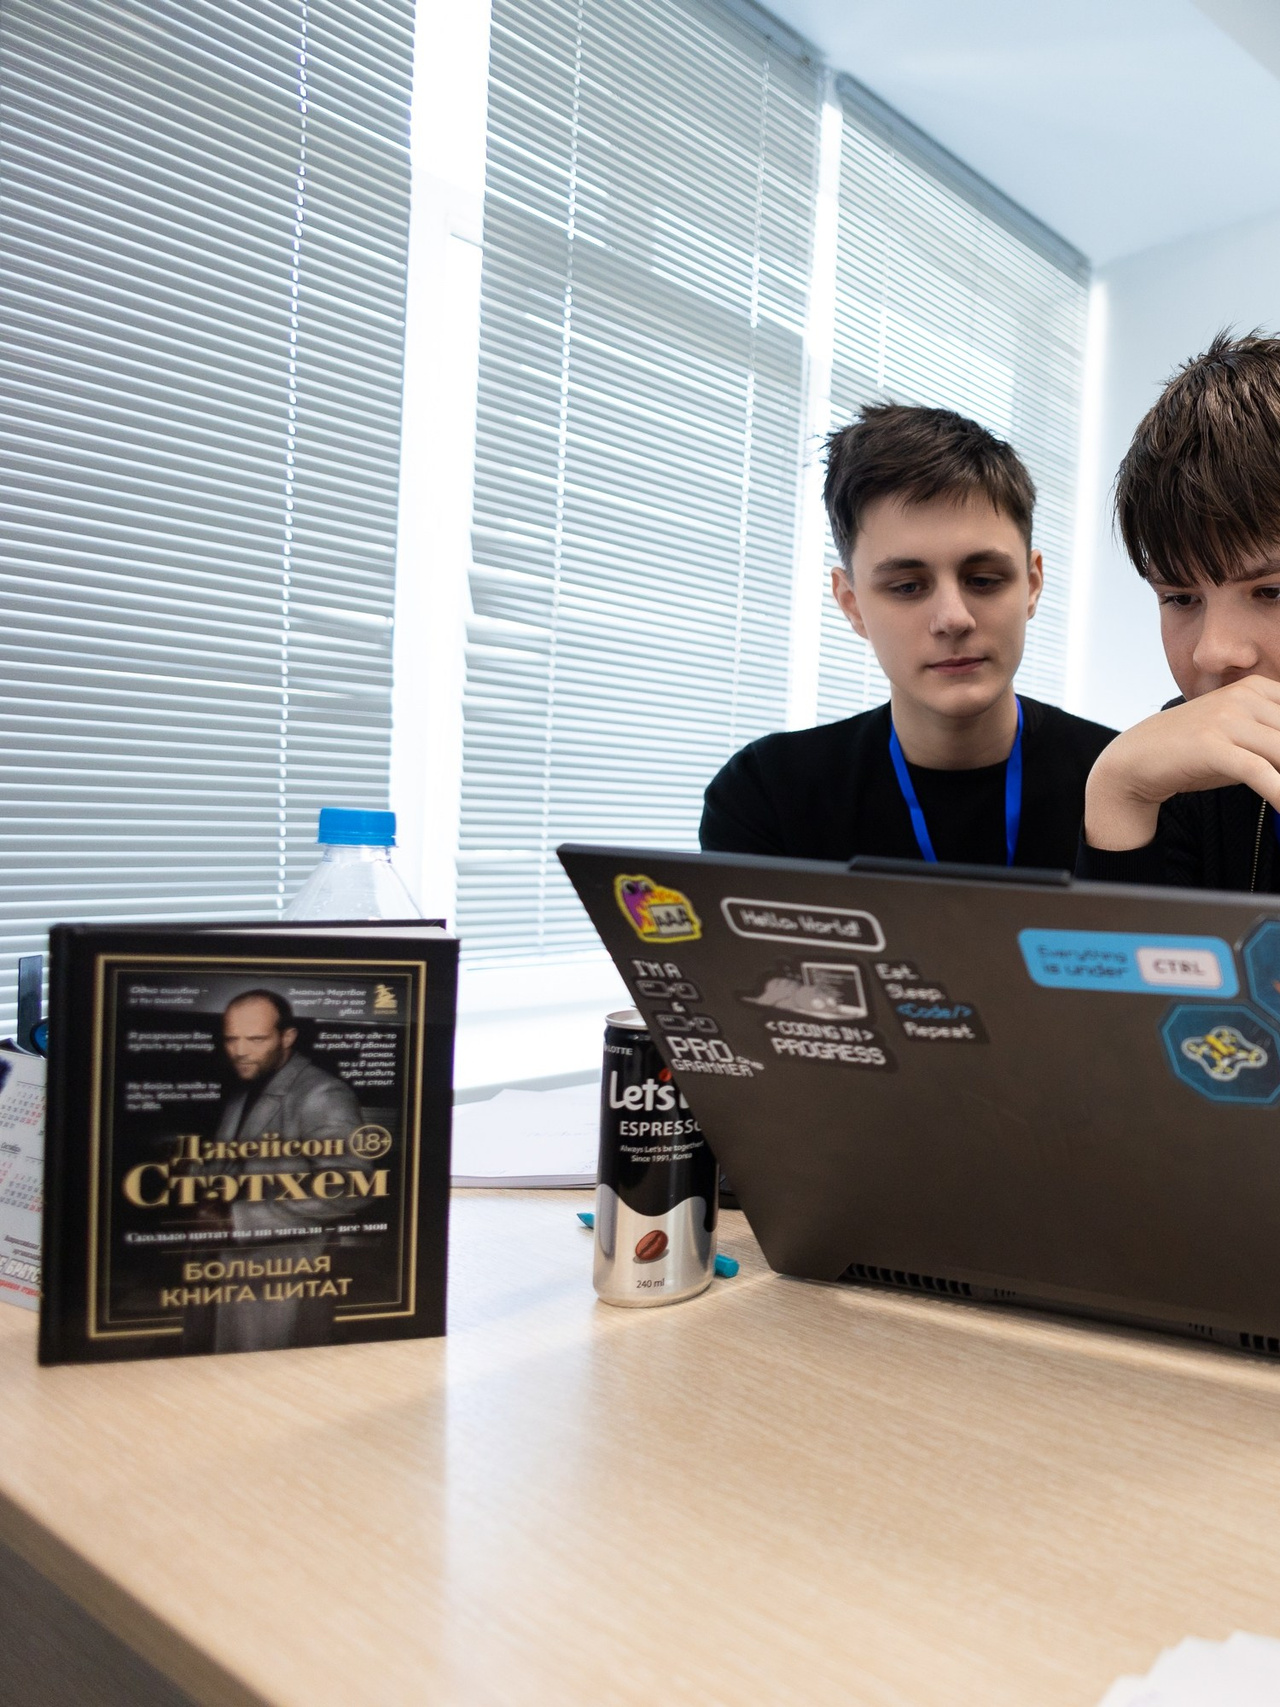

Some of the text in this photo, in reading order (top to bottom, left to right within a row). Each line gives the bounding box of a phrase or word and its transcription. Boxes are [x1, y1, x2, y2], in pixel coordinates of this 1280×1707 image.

[1037, 945, 1128, 963] Everything
[663, 963, 682, 978] A
[1044, 962, 1128, 977] is under
[1153, 958, 1206, 976] CTRL
[666, 1036, 735, 1063] PRO
[771, 1037, 886, 1065] PROGRESS
[671, 1059, 754, 1077] GRAMMER
[171, 1133, 391, 1164] Джейсон 18+
[123, 1163, 391, 1206] Стэтхем
[184, 1256, 331, 1281] БОЛЬШАЯ
[161, 1279, 352, 1307] КНИГА ЦИТАТ
[636, 1278, 665, 1289] 240 ml
